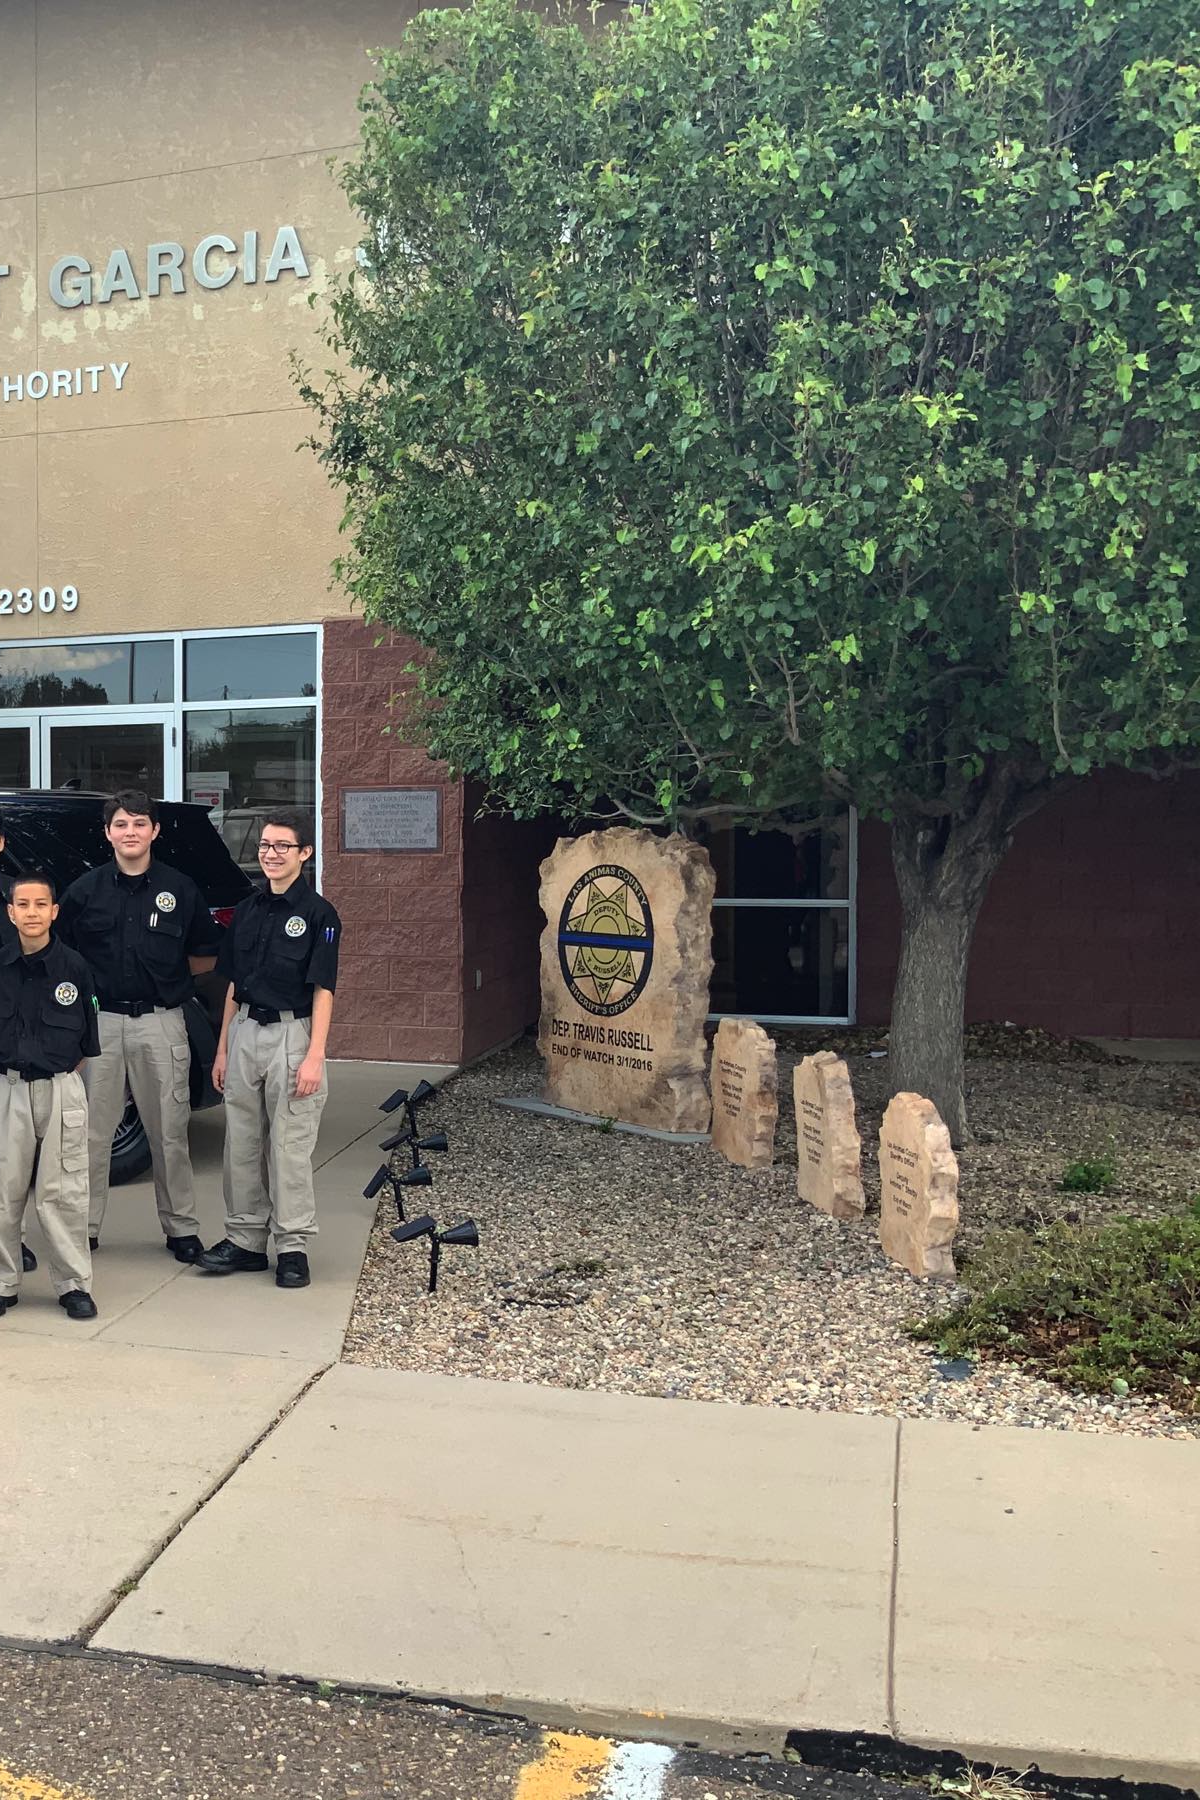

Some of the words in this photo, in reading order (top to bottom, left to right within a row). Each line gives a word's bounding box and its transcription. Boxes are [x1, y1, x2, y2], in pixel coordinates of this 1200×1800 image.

[49, 225, 311, 310] GARCIA
[568, 881, 583, 903] LAS
[584, 866, 616, 884] ANIMAS
[617, 869, 648, 905] COUNTY
[593, 905, 620, 917] DEPUTY
[609, 990, 638, 1015] OFFICE
[552, 1018, 570, 1038] DEP.
[572, 1022, 605, 1044] TRAVIS
[607, 1028, 654, 1052] RUSSELL
[552, 1043, 568, 1057] END
[570, 1047, 582, 1058] OF
[583, 1049, 615, 1065] WATCH
[616, 1055, 653, 1072] 3/1/2016
